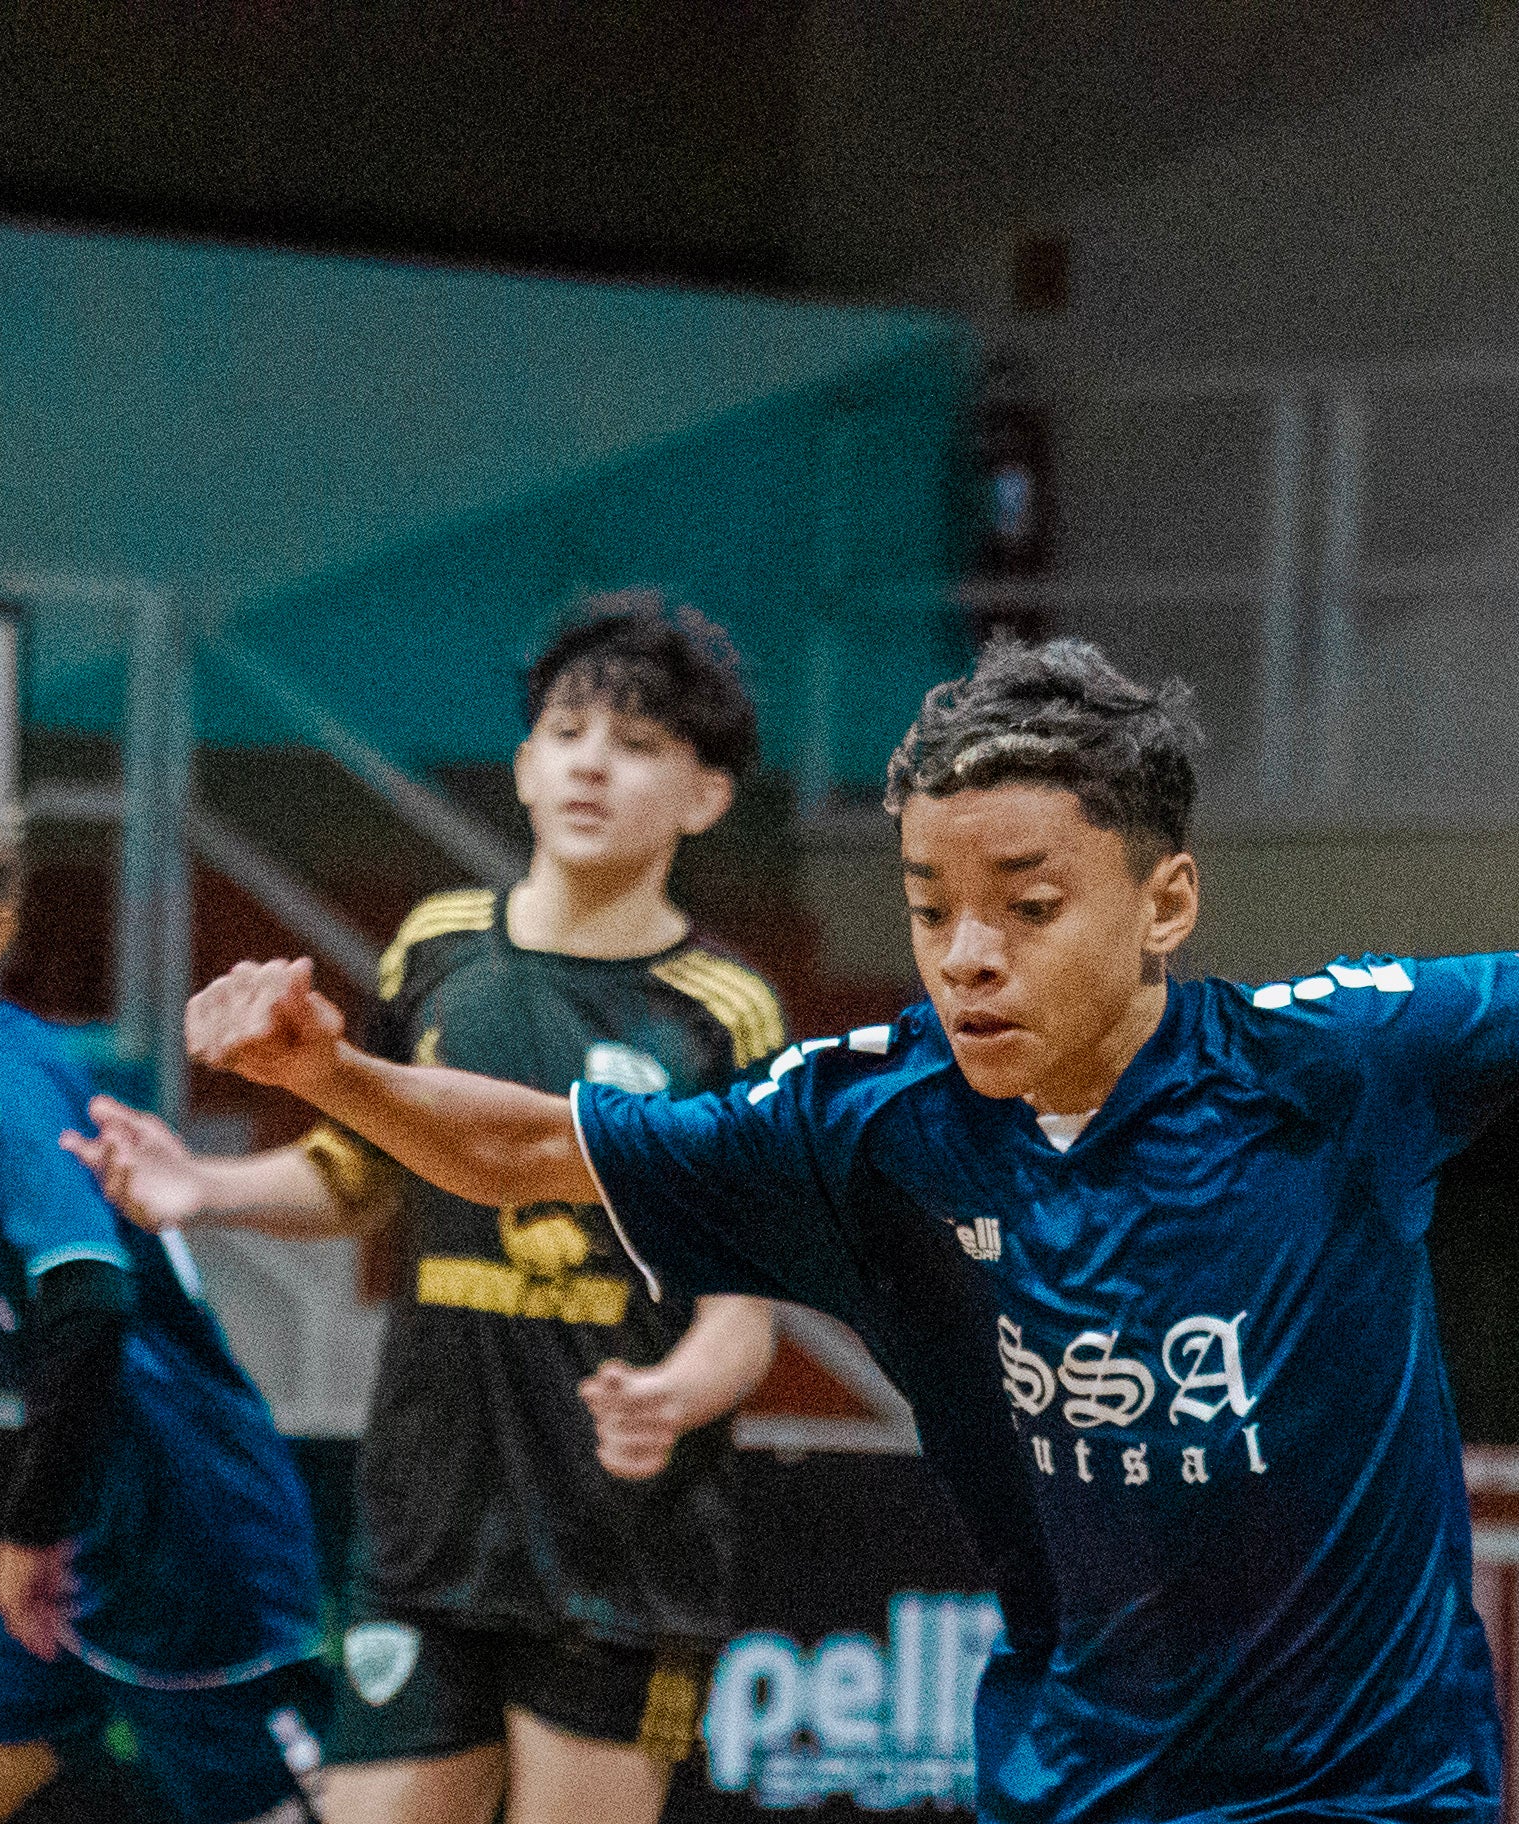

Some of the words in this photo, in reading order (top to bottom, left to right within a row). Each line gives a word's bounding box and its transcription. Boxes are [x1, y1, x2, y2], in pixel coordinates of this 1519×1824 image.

[956, 1216, 1001, 1250] elli
[997, 1309, 1256, 1429] SSA
[1031, 1422, 1269, 1485] utsal
